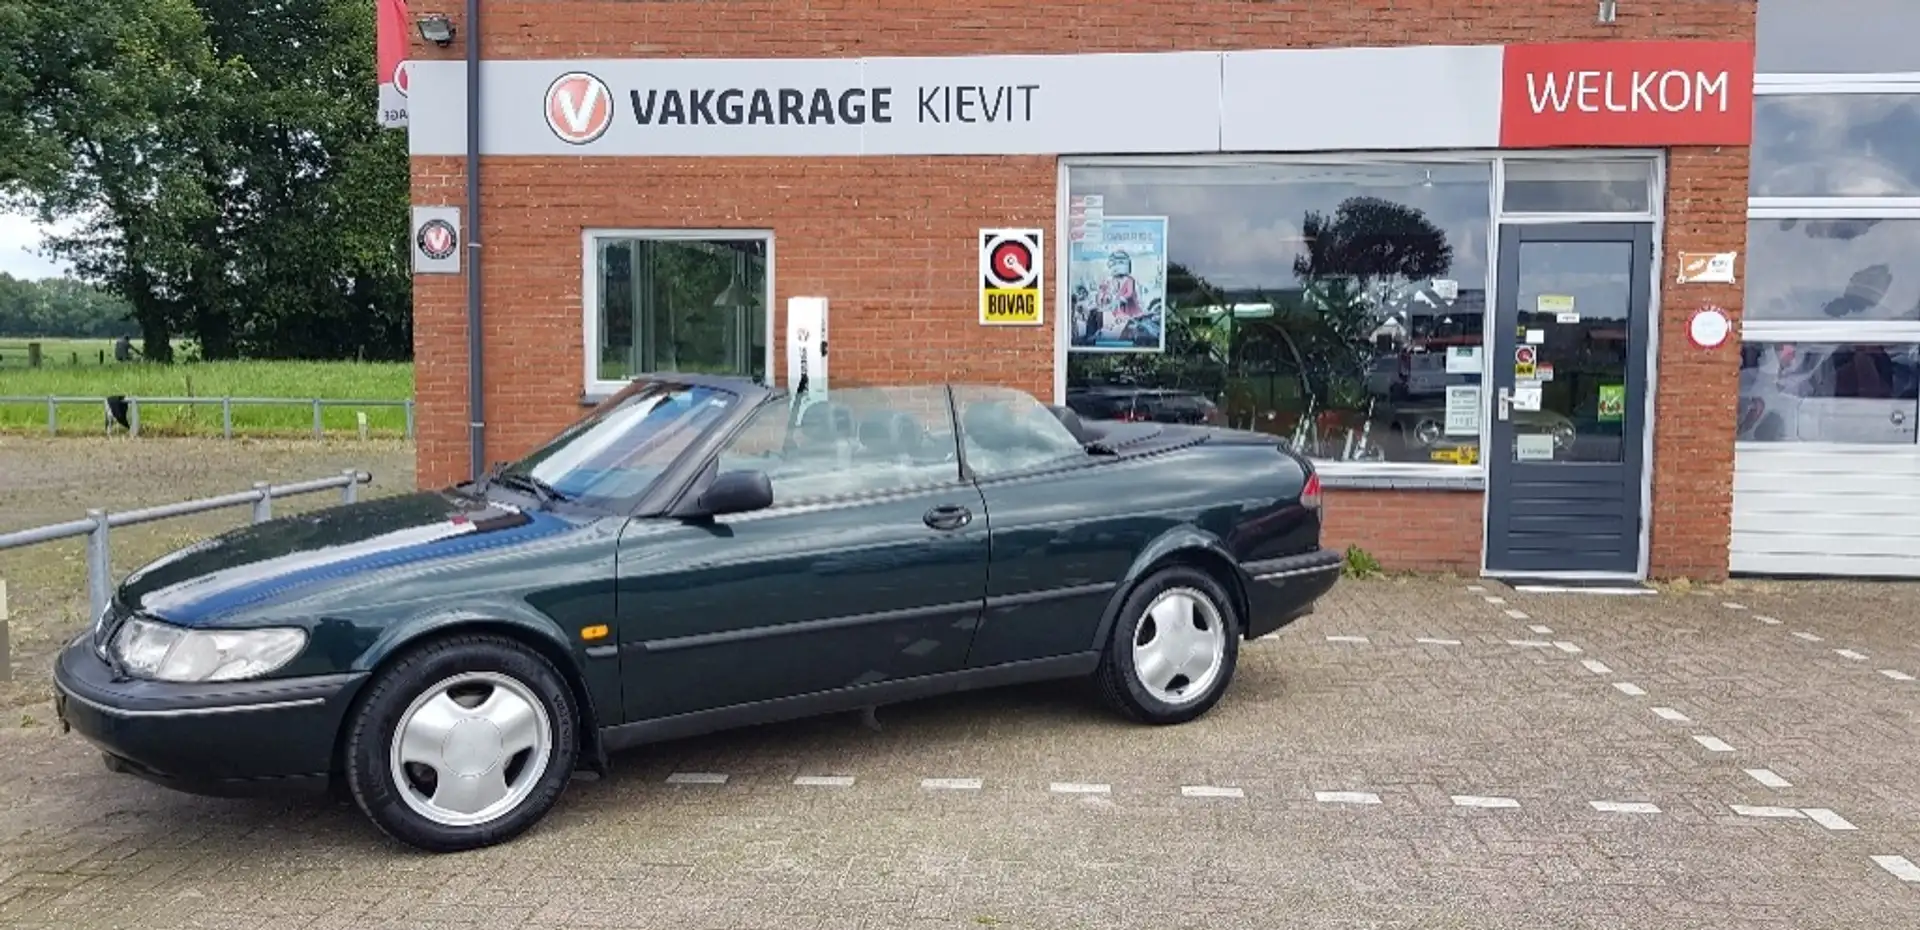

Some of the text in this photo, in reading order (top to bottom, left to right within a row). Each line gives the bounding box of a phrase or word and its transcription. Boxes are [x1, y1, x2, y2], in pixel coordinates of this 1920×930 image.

[629, 84, 1040, 125] VAKGARAGE KIEVIT
[1526, 70, 1728, 113] WELKOM
[988, 294, 1034, 316] BOVAG
